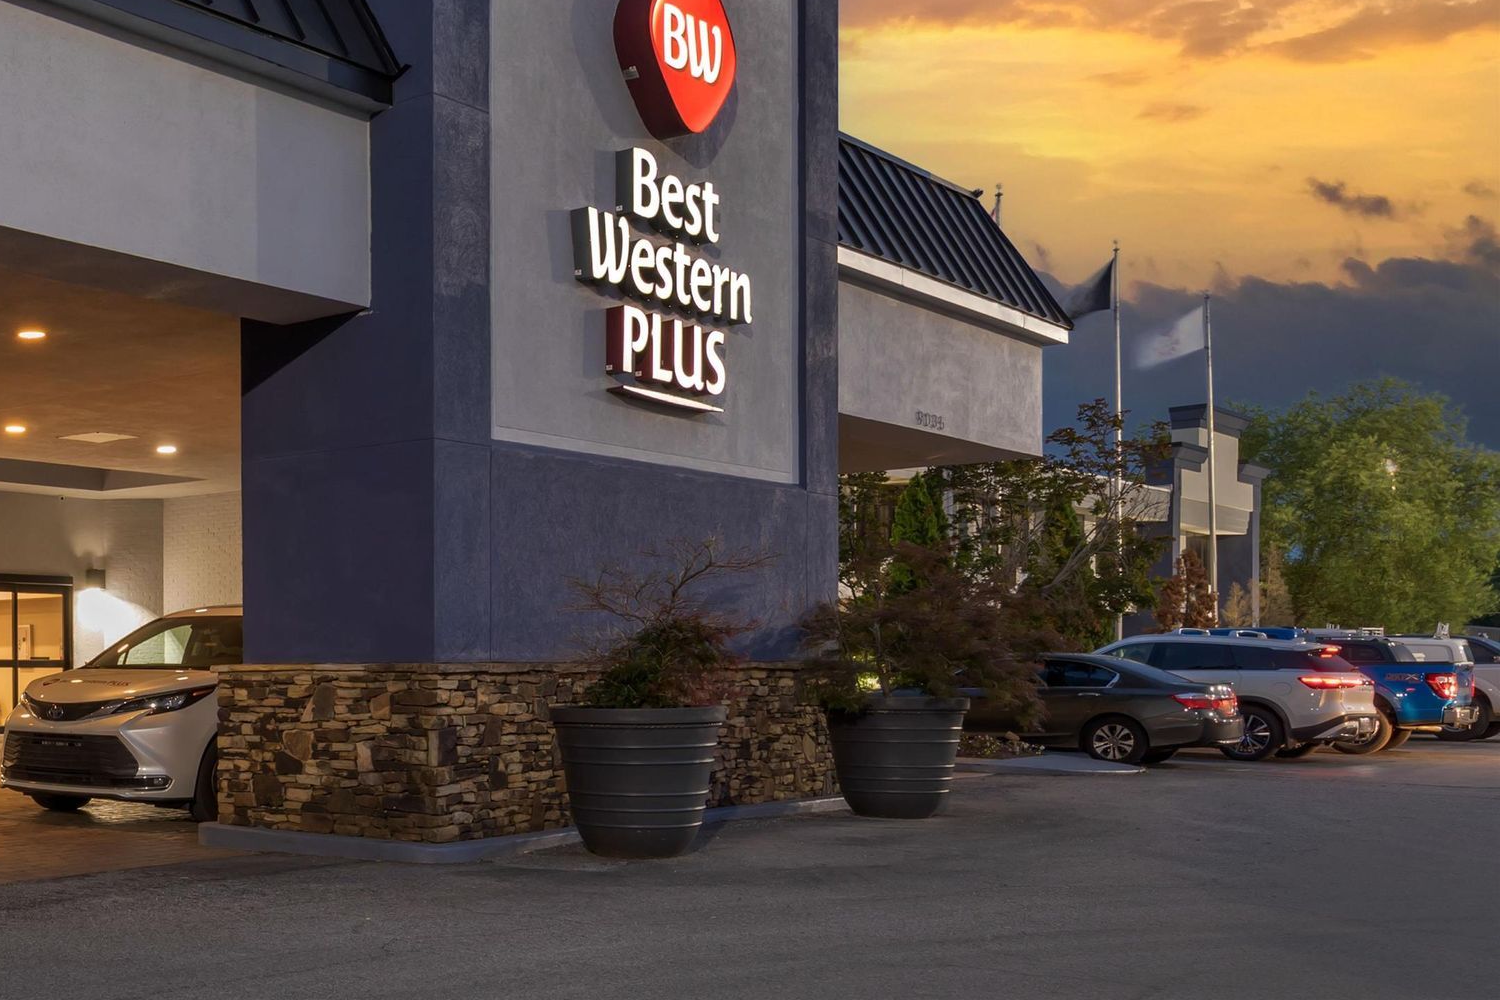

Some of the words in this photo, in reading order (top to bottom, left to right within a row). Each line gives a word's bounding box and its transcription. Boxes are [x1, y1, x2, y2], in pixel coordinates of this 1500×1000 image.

[664, 3, 722, 84] BW
[632, 147, 720, 243] Best
[587, 206, 752, 324] Western
[622, 304, 726, 395] PLUS
